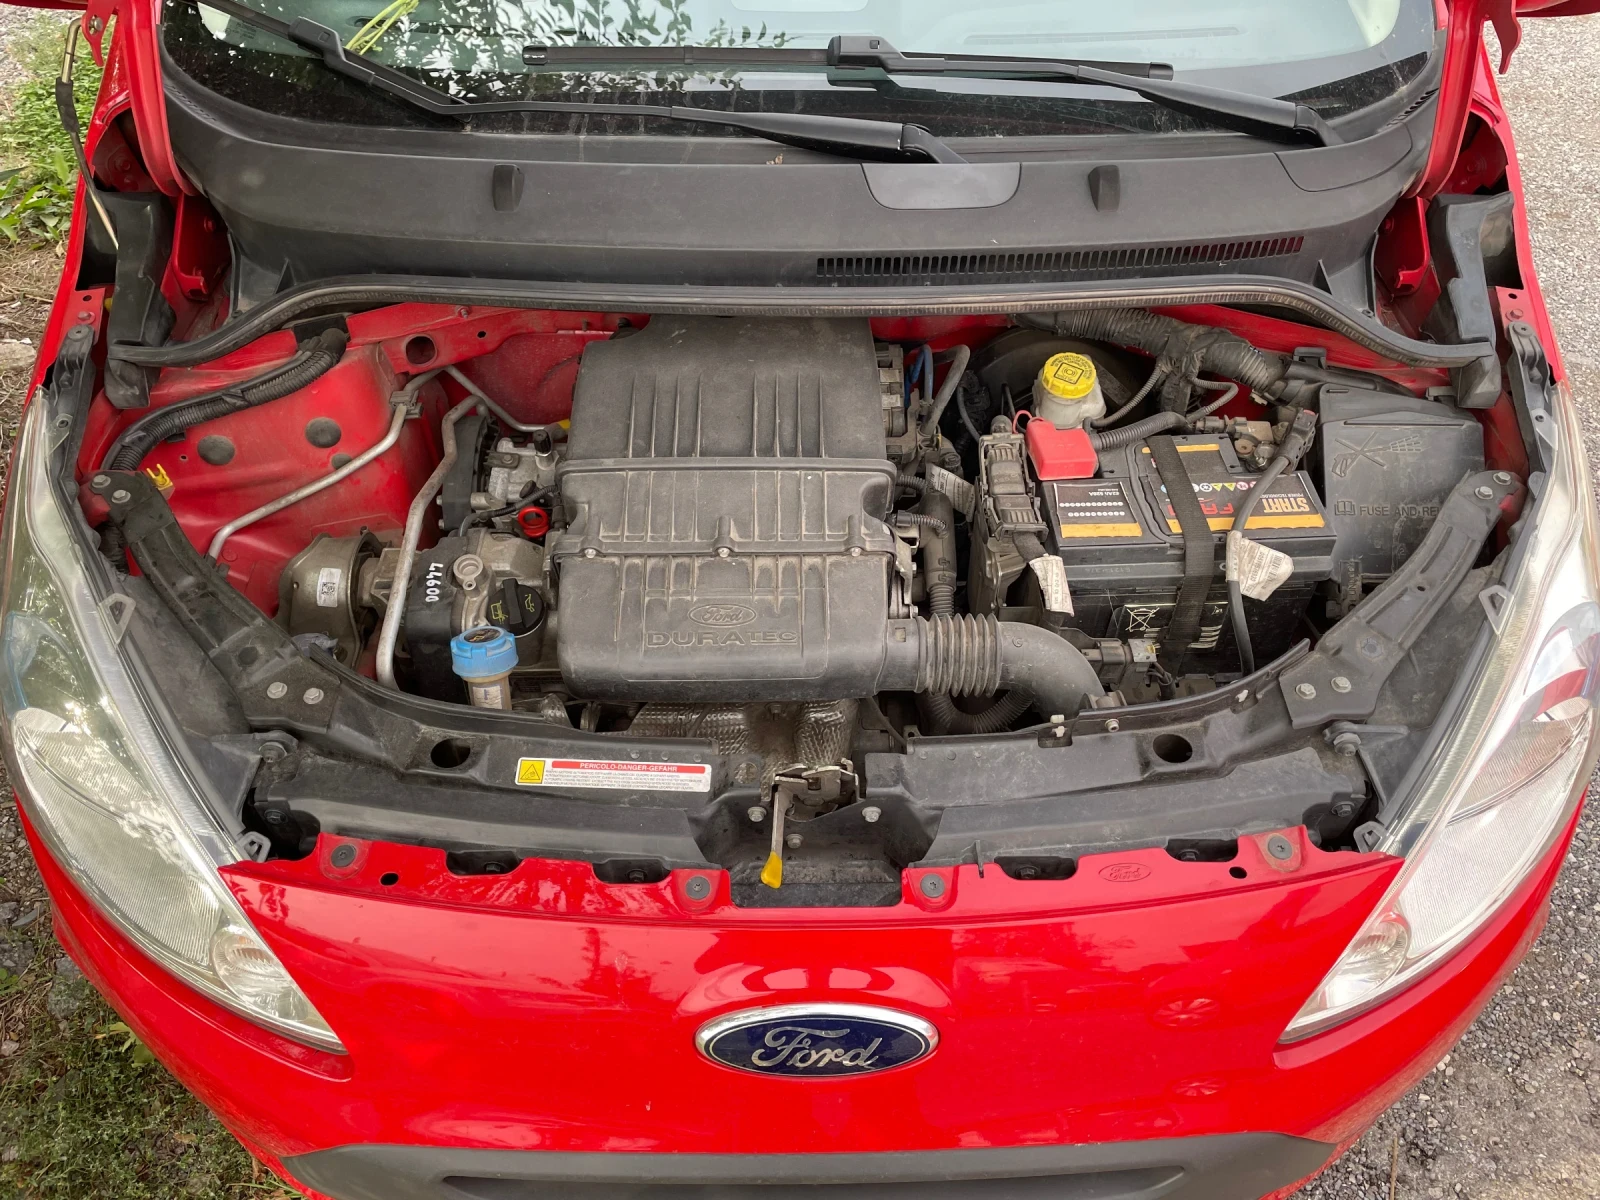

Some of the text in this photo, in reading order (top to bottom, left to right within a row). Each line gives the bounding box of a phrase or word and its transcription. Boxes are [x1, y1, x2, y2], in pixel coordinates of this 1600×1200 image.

[1262, 497, 1310, 513] START
[1359, 506, 1389, 516] FUSE
[1394, 506, 1417, 516] AND
[425, 562, 444, 603] 44600
[701, 605, 743, 623] Ford
[646, 630, 797, 647] DURATEC
[579, 762, 678, 772] PERICOLO-DANGER-GEFAHR
[751, 1026, 883, 1069] Ford
